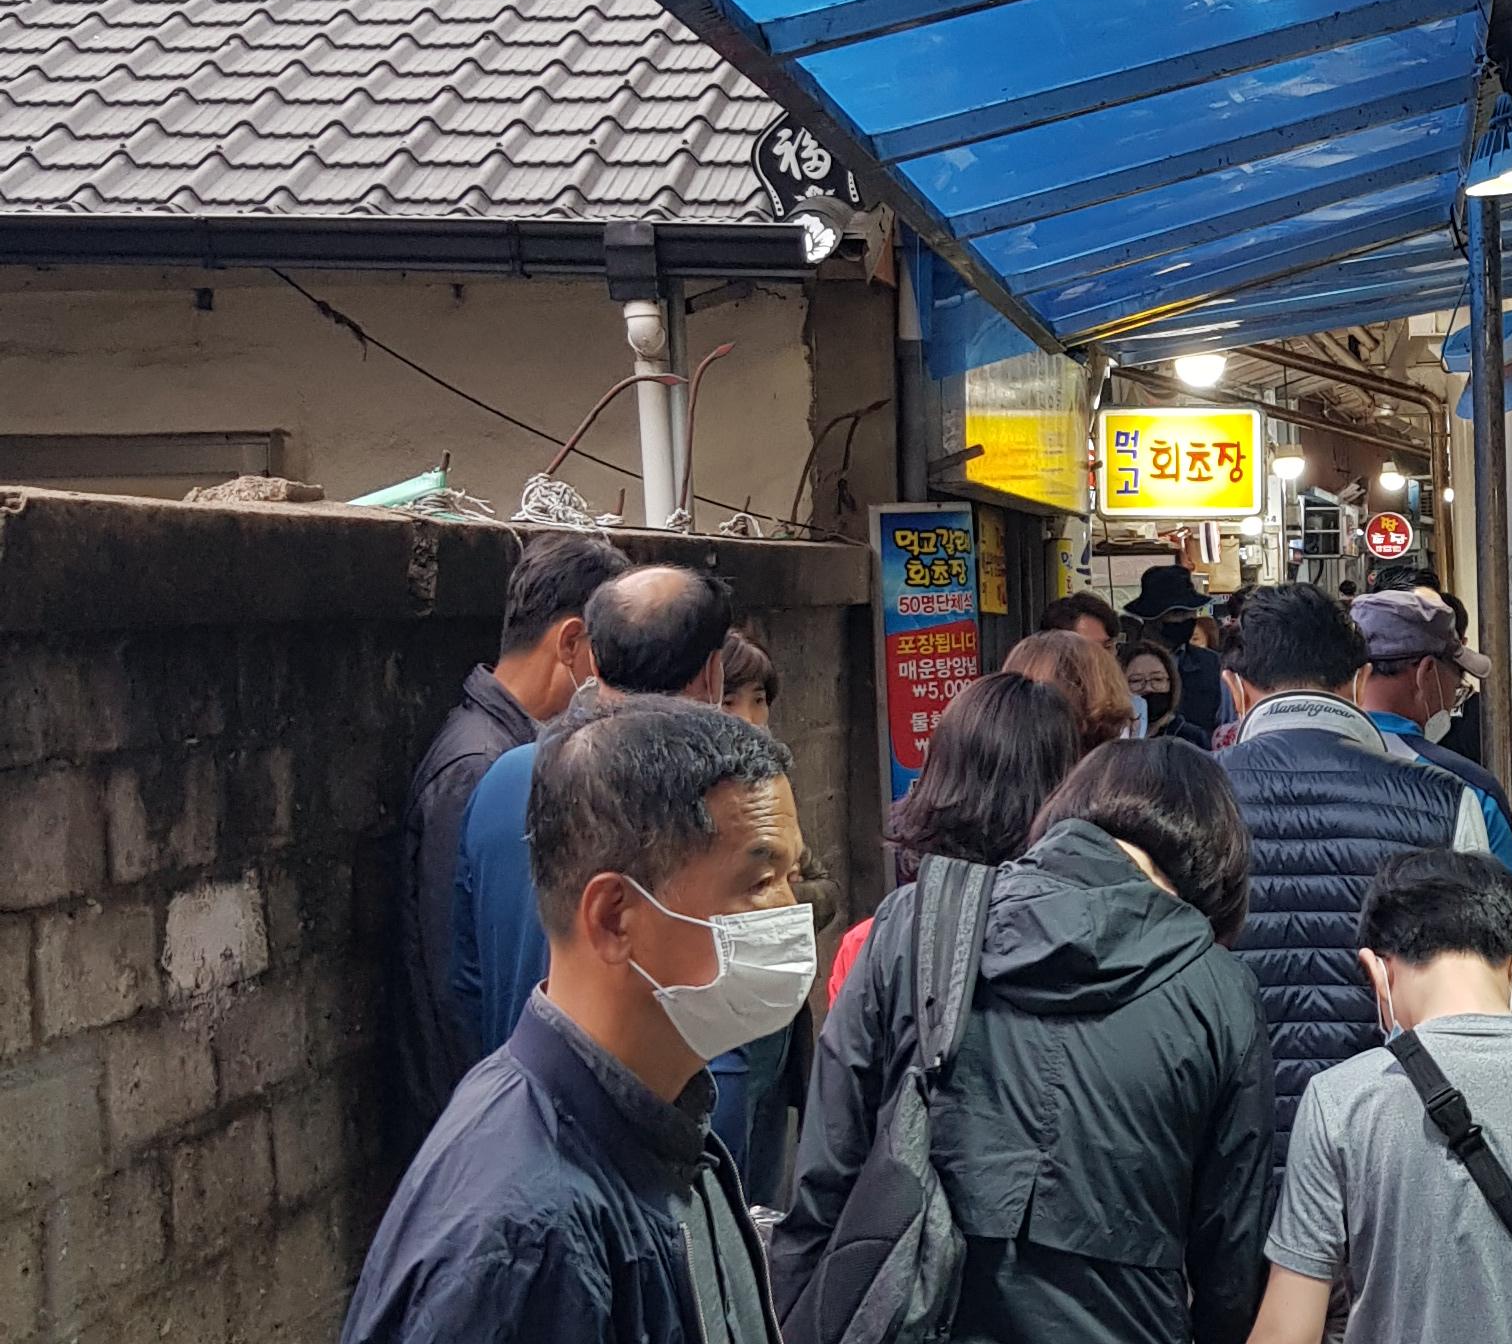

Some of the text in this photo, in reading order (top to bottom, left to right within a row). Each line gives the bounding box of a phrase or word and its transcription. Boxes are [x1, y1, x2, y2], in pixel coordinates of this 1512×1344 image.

[772, 127, 832, 181] 福
[1114, 430, 1140, 495] 먹고
[1150, 439, 1247, 483] 회초장
[905, 558, 968, 587] 회초장
[896, 629, 977, 656] 포장됩니다
[898, 655, 978, 681] 매운탕양념
[1262, 700, 1356, 720] Mansingwear
